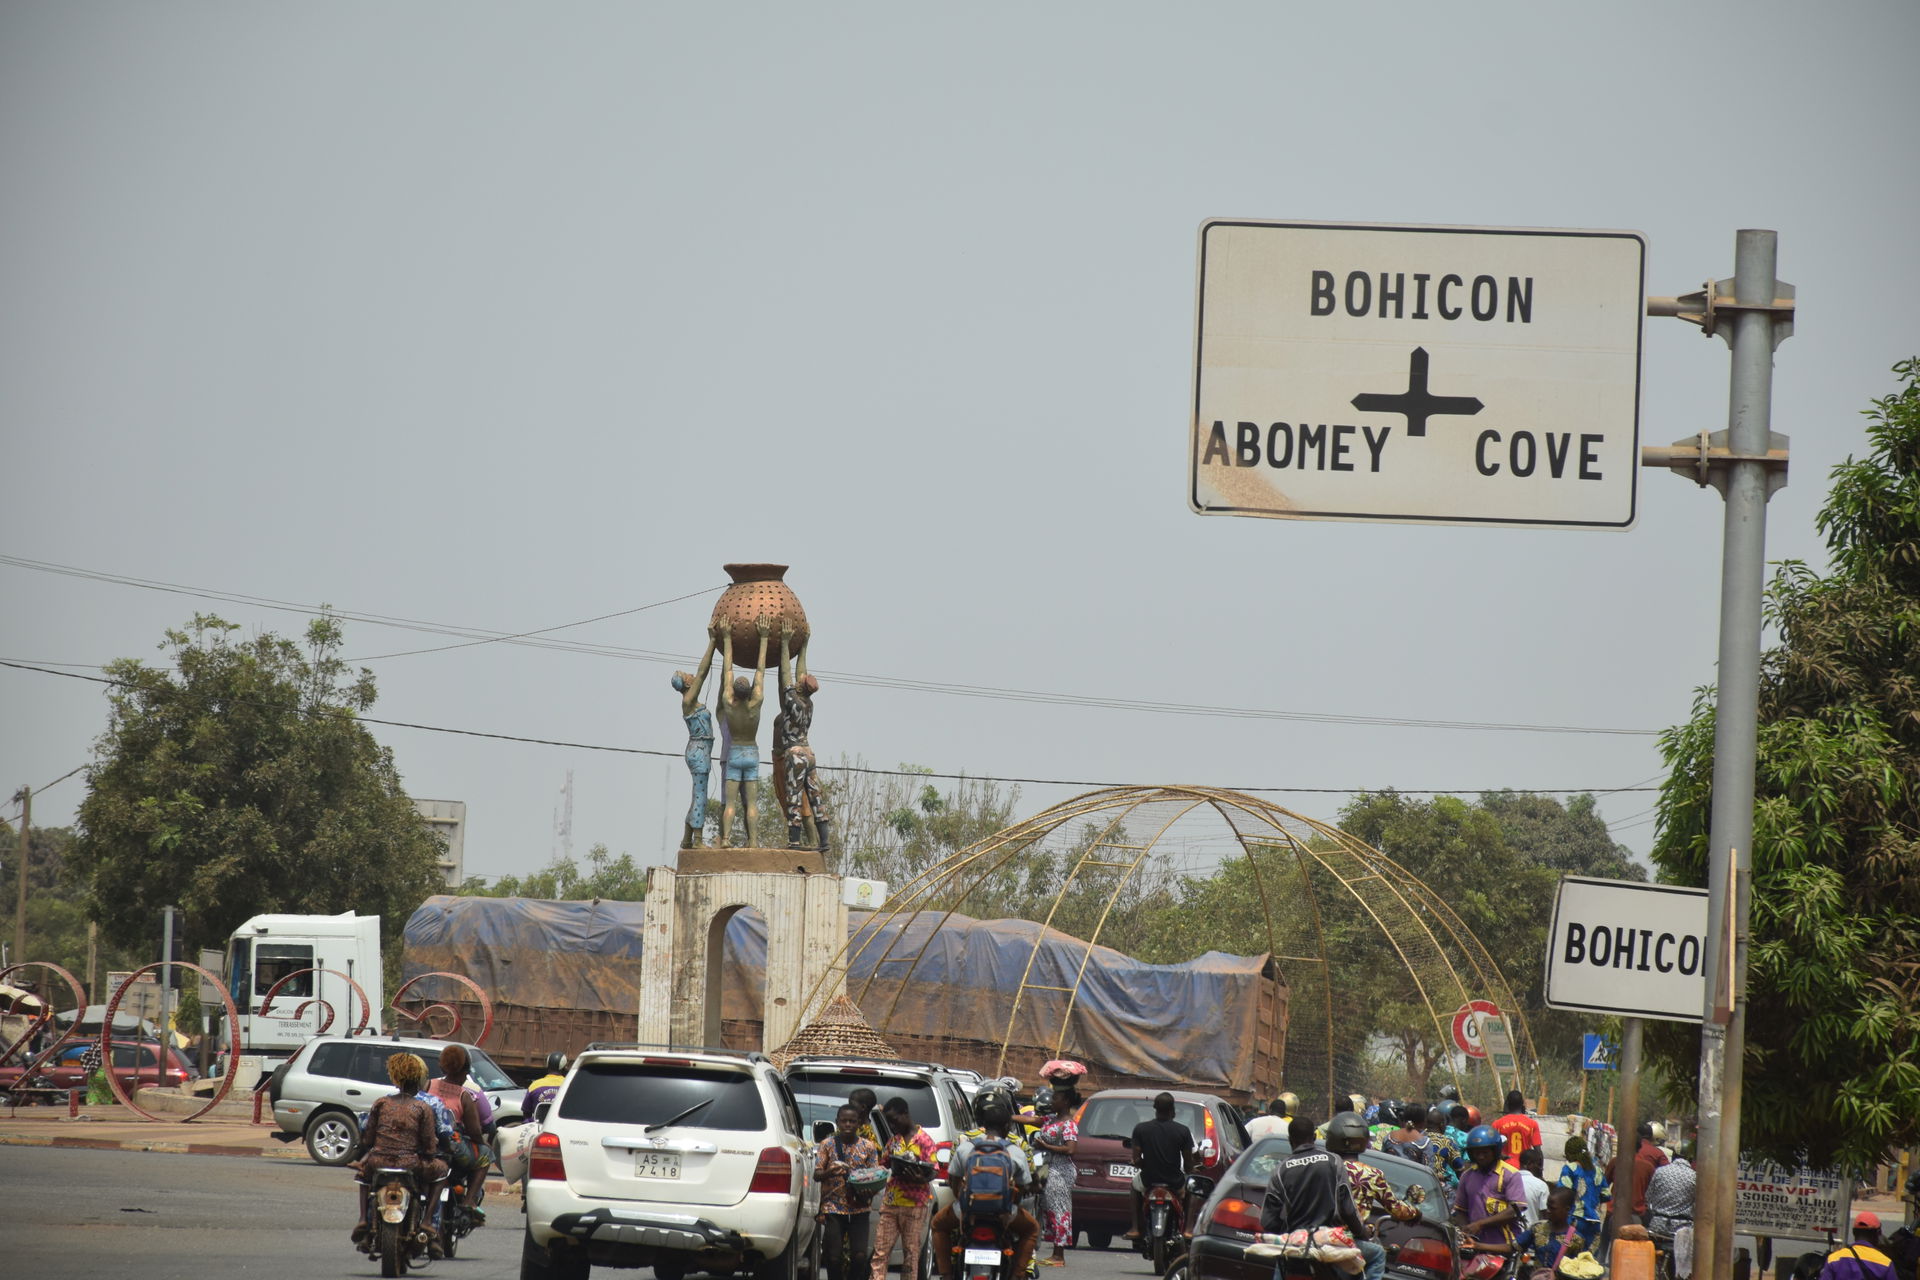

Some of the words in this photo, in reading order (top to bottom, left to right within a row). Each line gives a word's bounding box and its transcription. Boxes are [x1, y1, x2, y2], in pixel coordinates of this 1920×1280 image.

[1310, 270, 1534, 323] BOHICON
[1202, 420, 1391, 472] ABOMEY
[1475, 429, 1605, 480] COVE
[1564, 922, 1707, 977] BOHICO
[1511, 1132, 1522, 1154] 6
[643, 1155, 658, 1164] AS
[1286, 1154, 1328, 1168] Kappa
[639, 1165, 677, 1177] 7418
[1112, 1166, 1139, 1176] BZ49
[1737, 1182, 1818, 1196] BAR-VIP
[1772, 1175, 1791, 1185] DE
[1800, 1177, 1839, 1190] FETE
[1743, 1192, 1788, 1204] SOGBO
[1796, 1197, 1836, 1208] ALIHO
